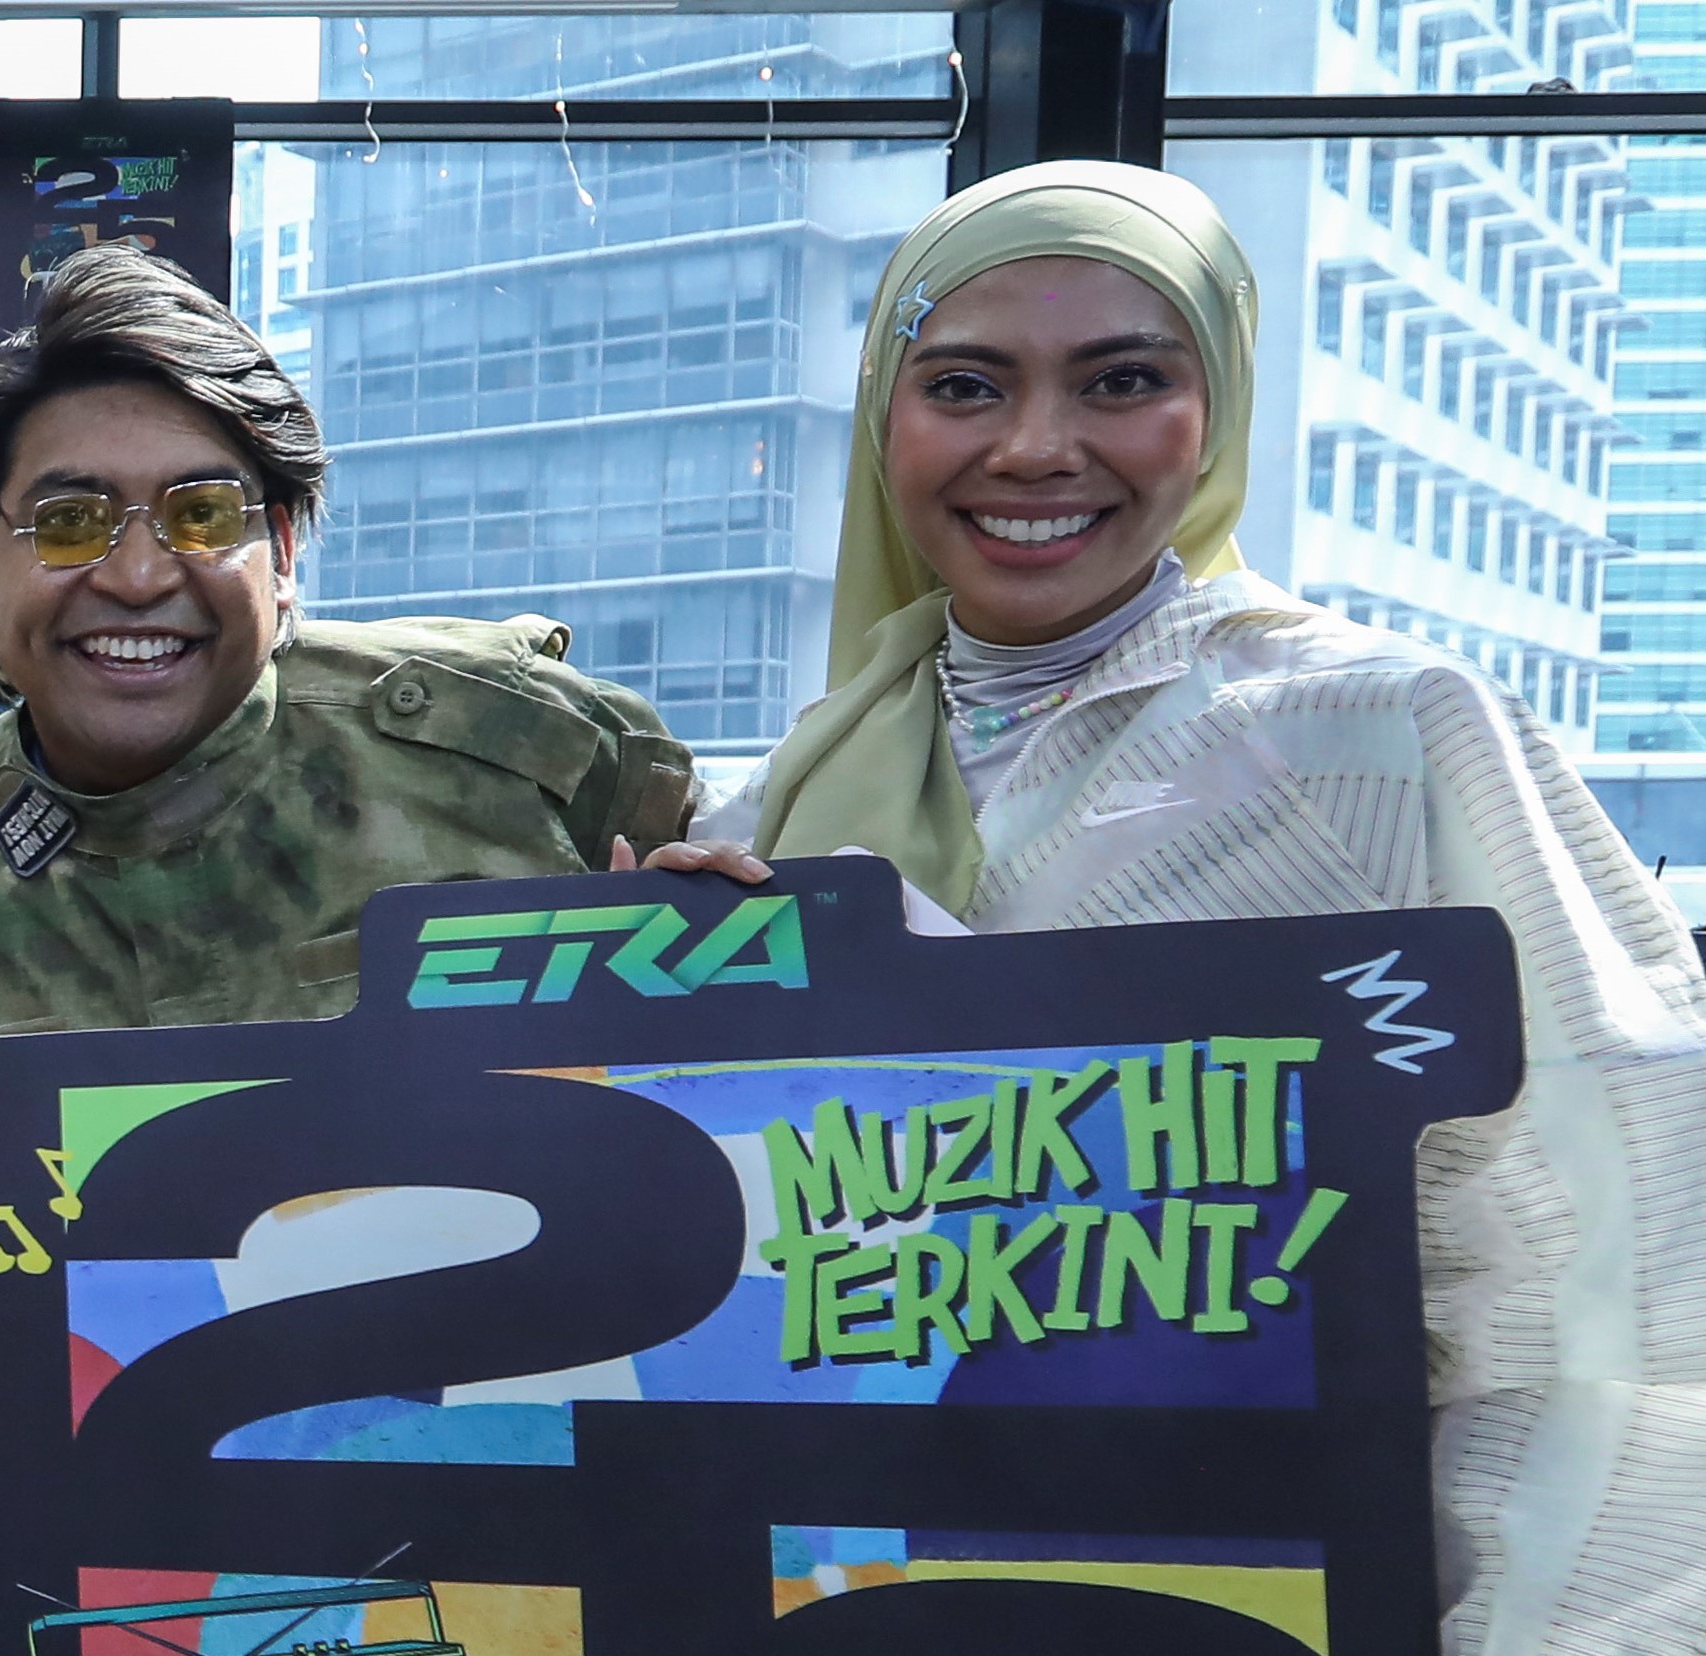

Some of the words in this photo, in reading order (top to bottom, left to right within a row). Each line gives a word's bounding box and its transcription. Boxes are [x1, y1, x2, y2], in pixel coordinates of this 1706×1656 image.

[11, 830, 45, 868] NOW
[407, 894, 810, 1009] ERA
[761, 1059, 1118, 1229] MUZIK
[1119, 1036, 1322, 1192] HIT
[759, 1187, 1349, 1363] TERKINI!
